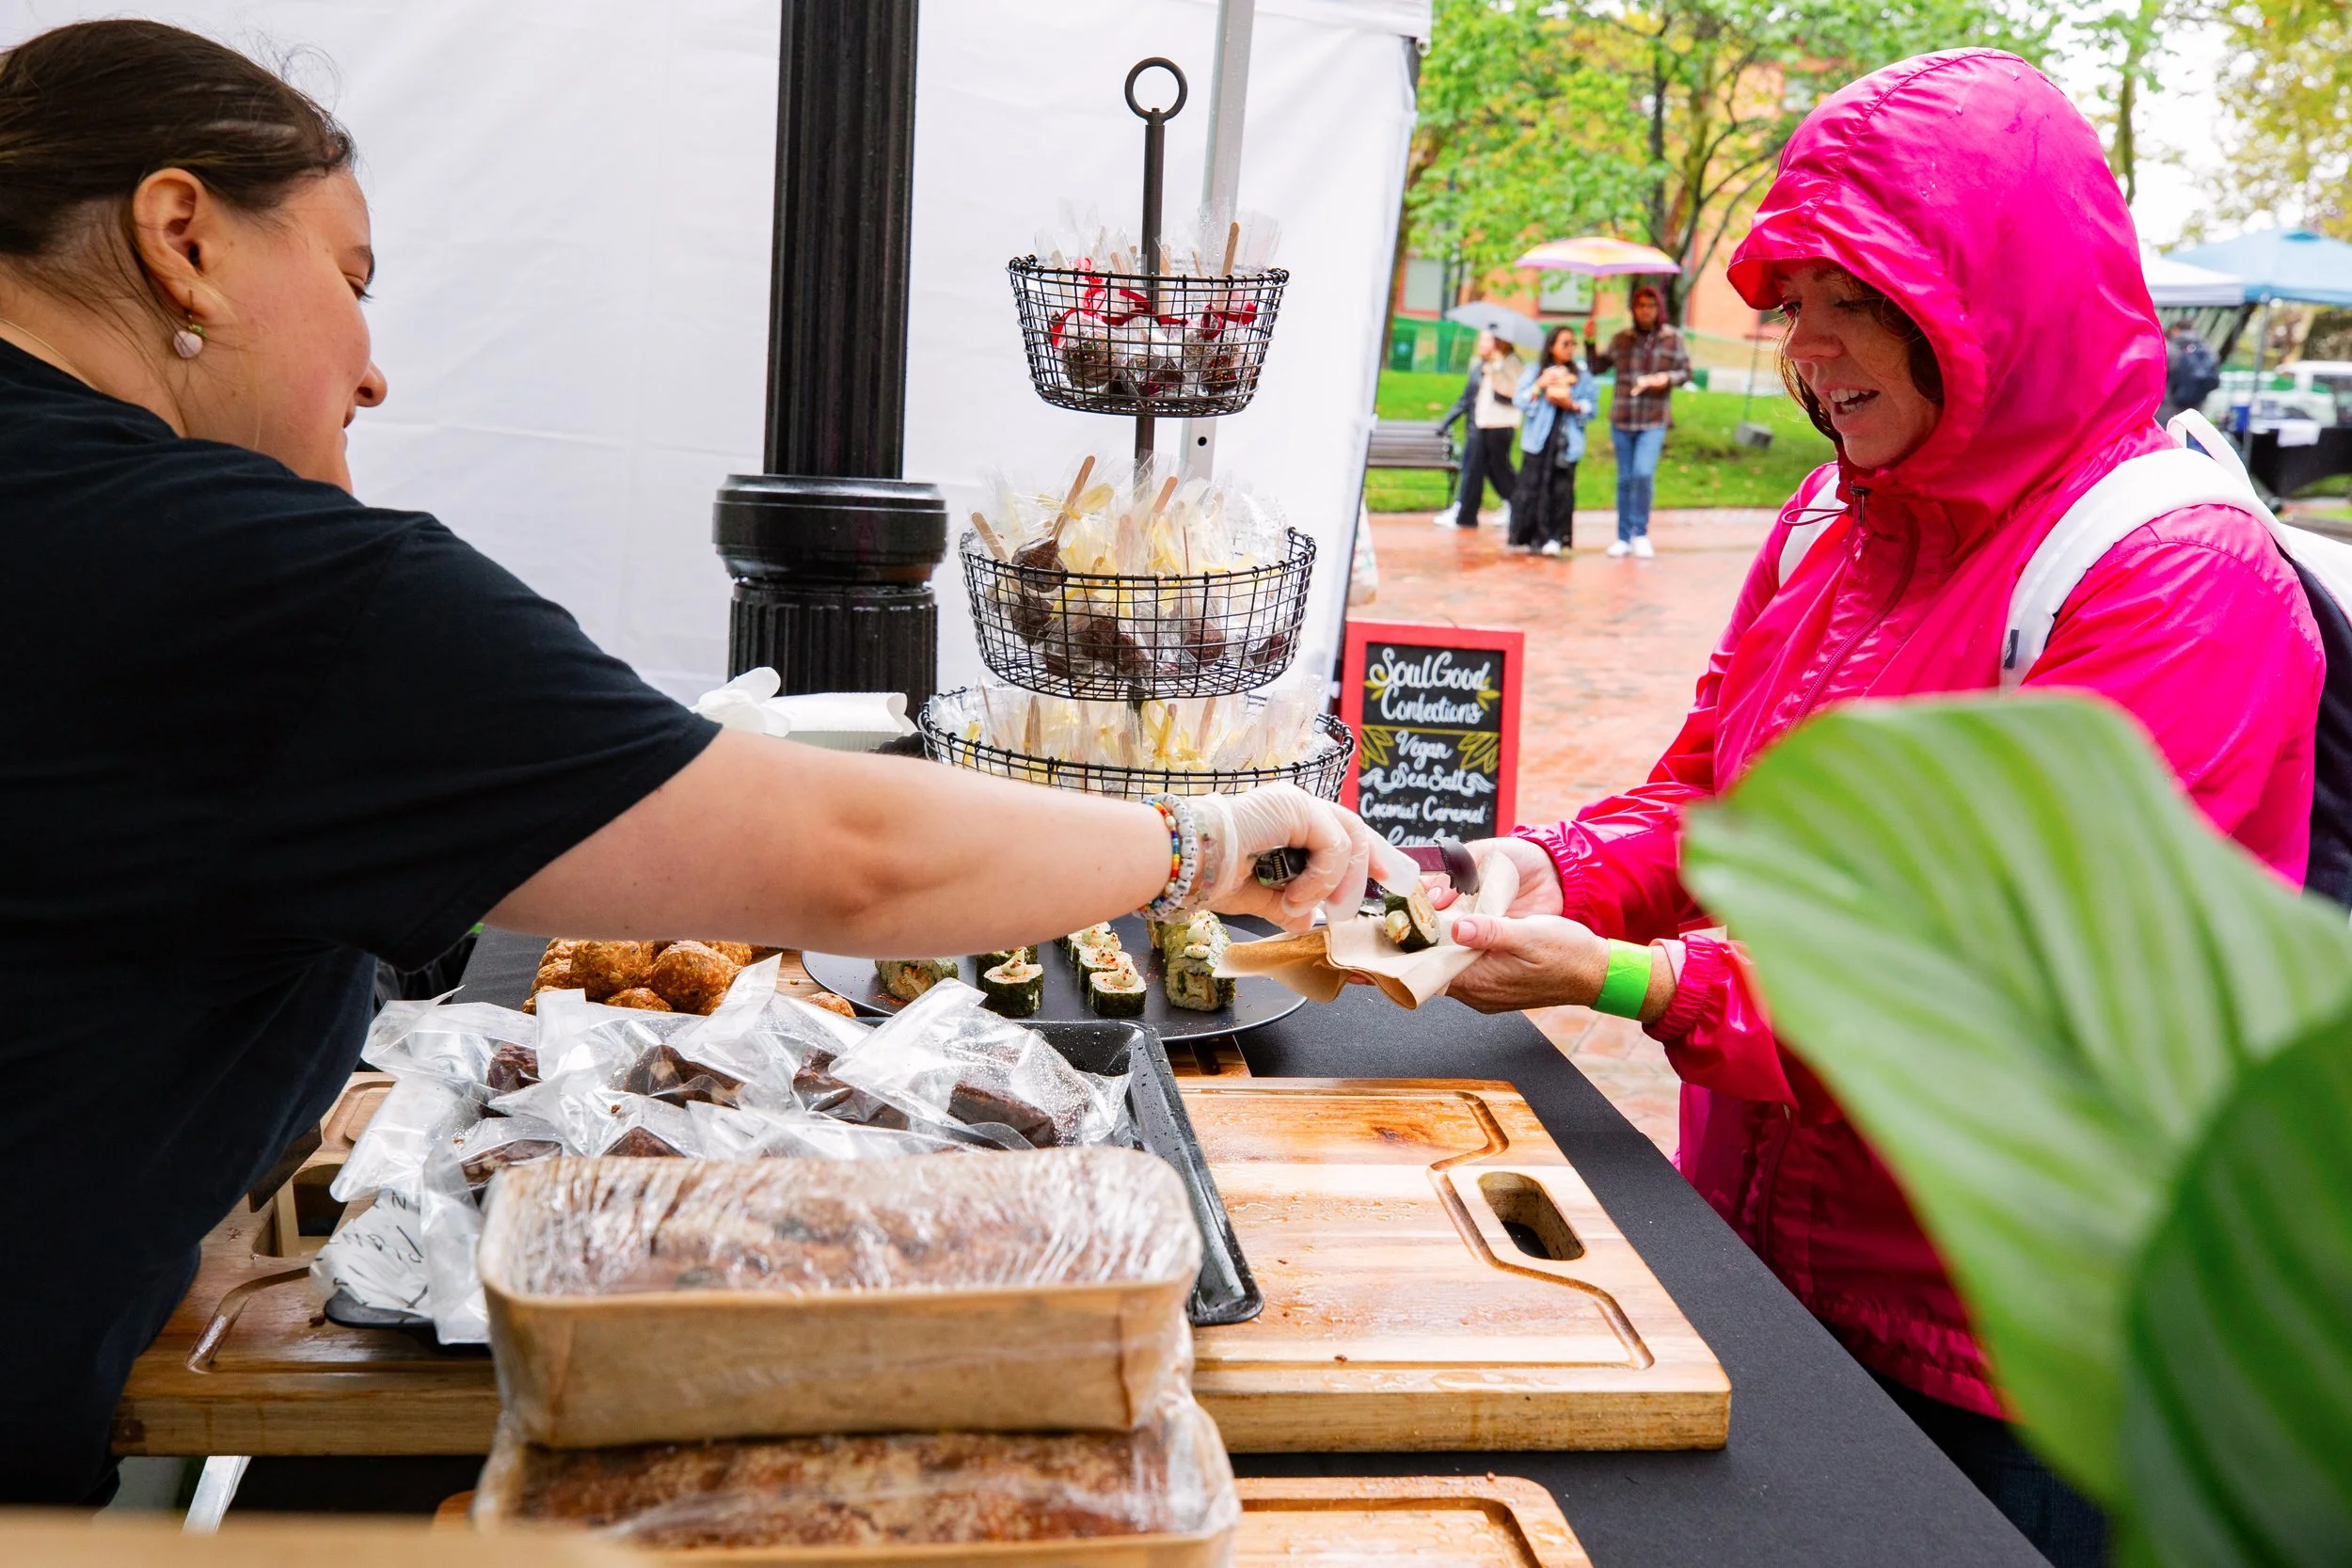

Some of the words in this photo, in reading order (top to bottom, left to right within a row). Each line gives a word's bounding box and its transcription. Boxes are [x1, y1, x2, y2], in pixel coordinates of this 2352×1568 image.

[1381, 683, 1485, 724] Confections
[1395, 729, 1454, 770] Vegan
[1359, 792, 1421, 820] Coconut
[1422, 795, 1486, 824] Caramel
